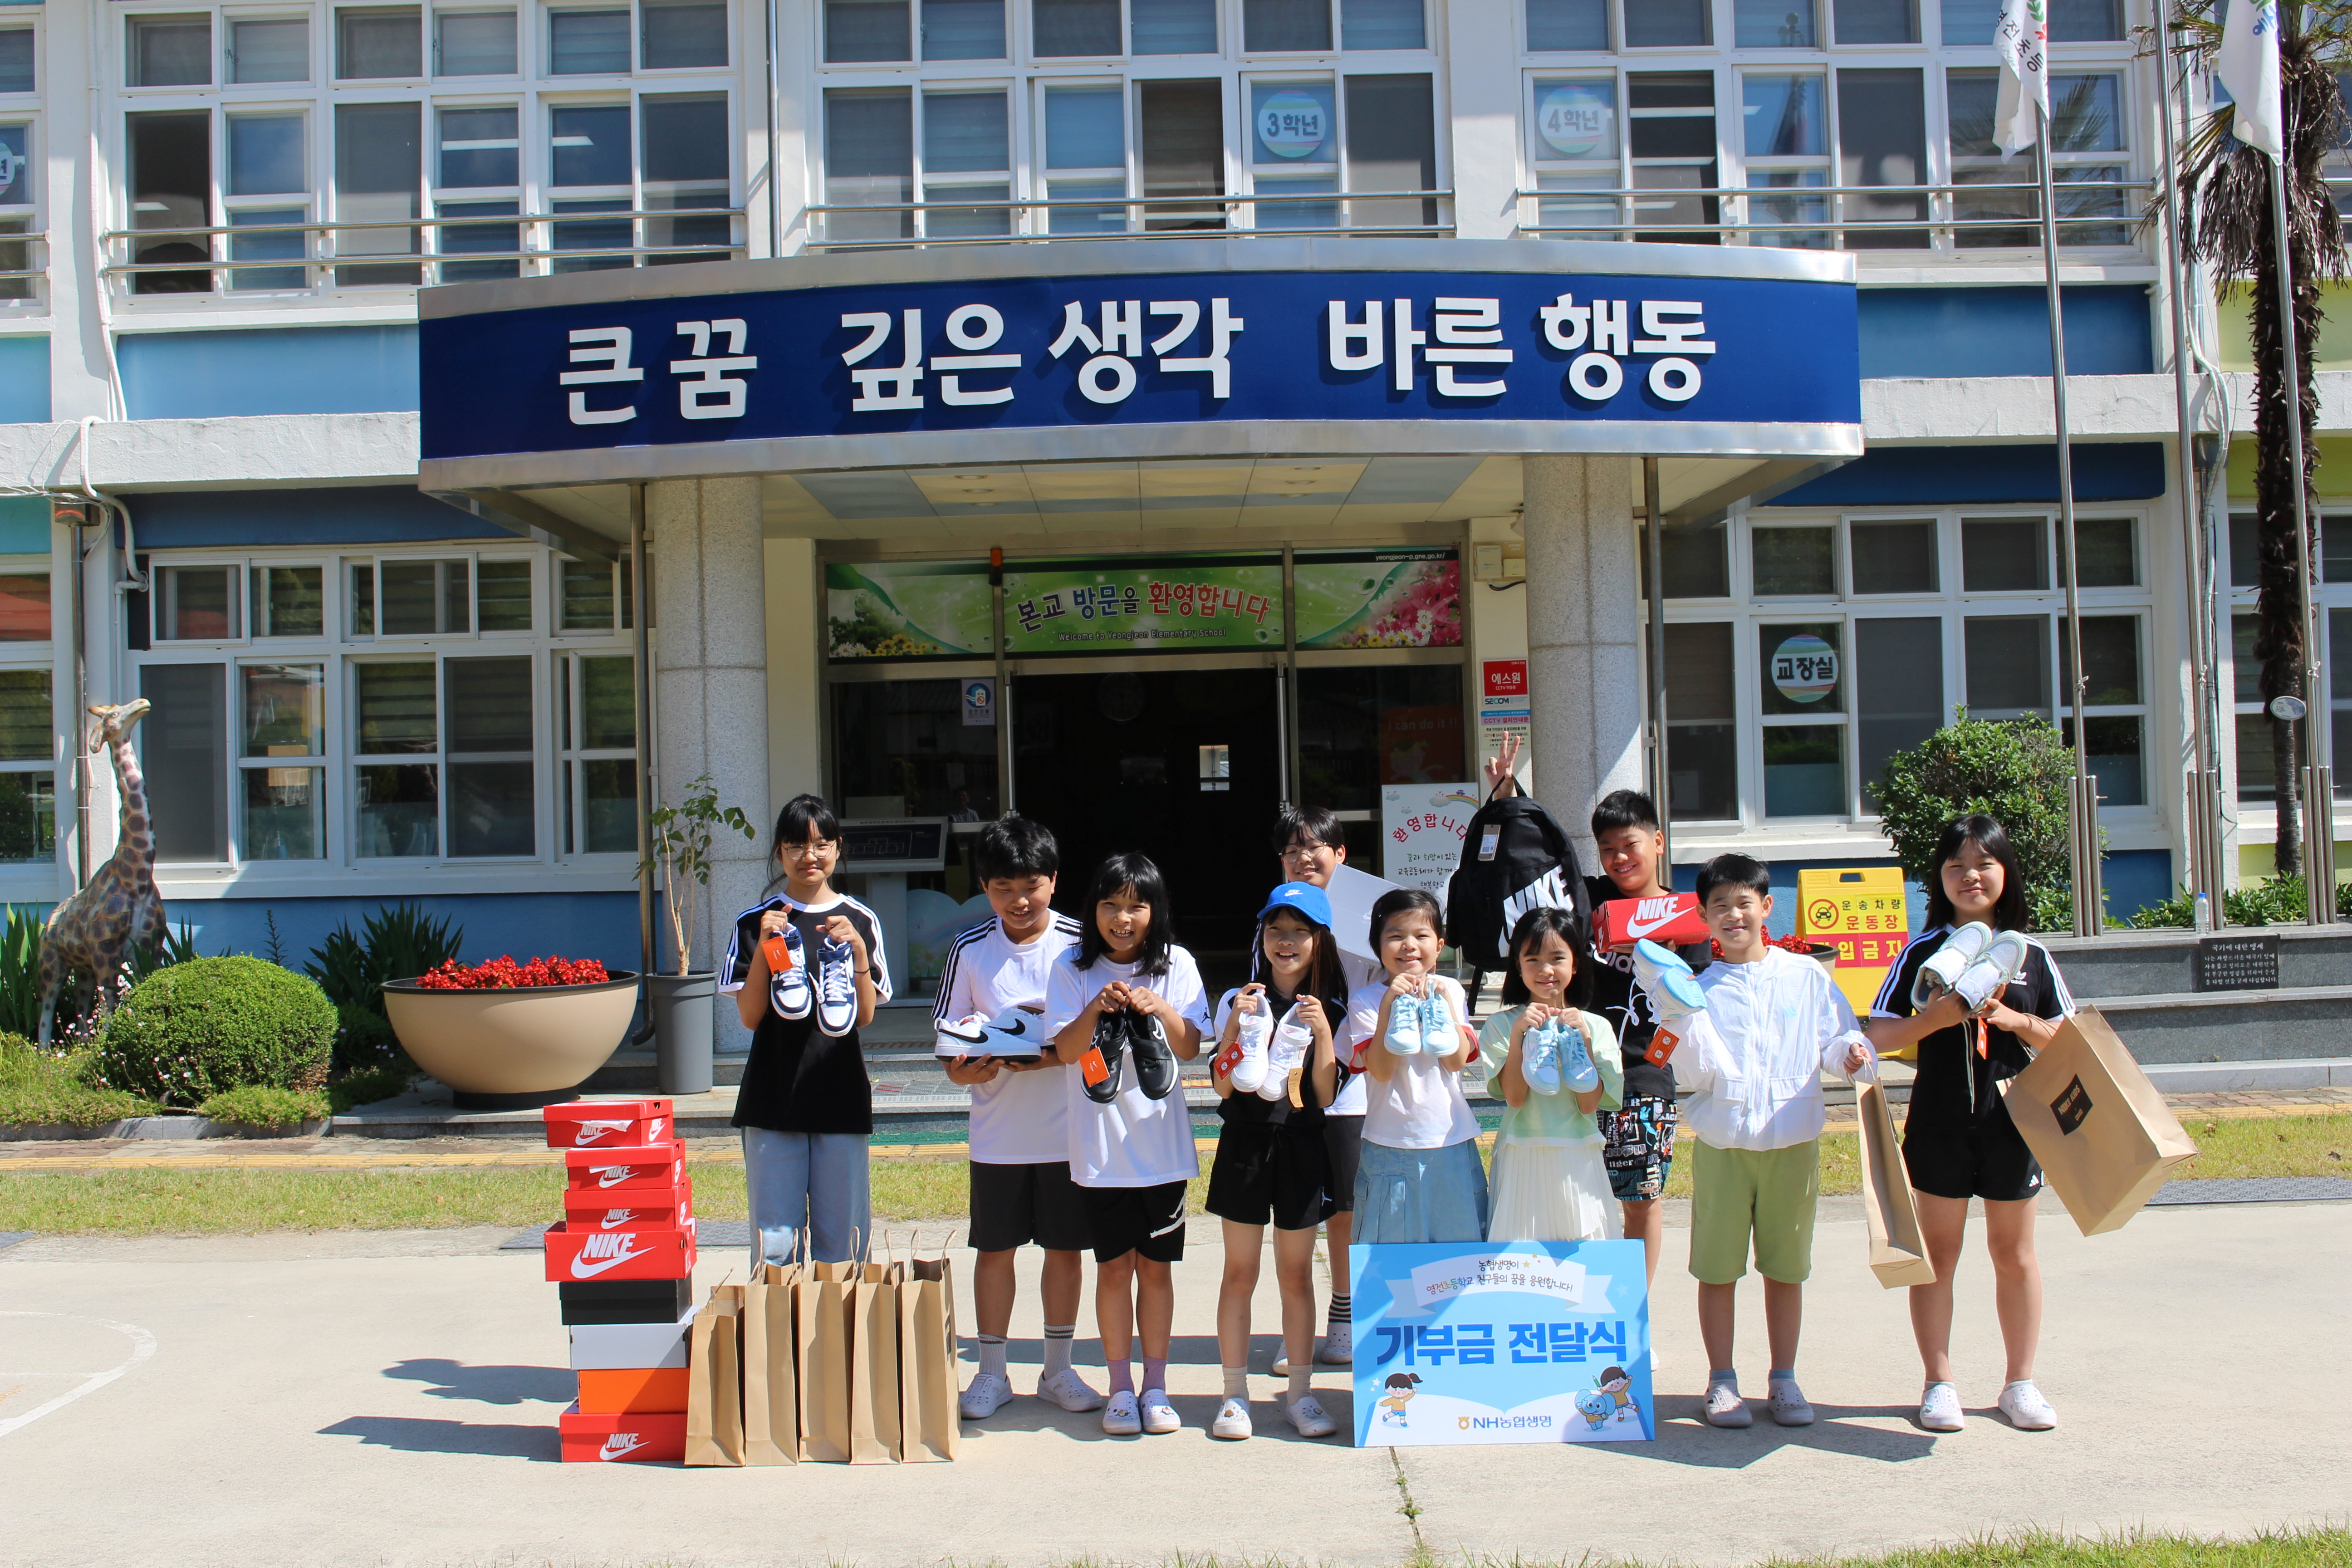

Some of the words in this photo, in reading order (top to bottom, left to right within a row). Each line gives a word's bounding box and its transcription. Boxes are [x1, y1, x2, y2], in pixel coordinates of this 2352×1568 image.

[560, 326, 644, 425] 큰
[670, 318, 757, 420] 꿈
[841, 304, 1022, 412] 깊은
[1049, 297, 1244, 404] 생각
[1329, 297, 1513, 397] 바른
[1540, 293, 1716, 402] 행동
[1017, 593, 1067, 633] 본교
[1073, 584, 1141, 620] 방문을
[1147, 581, 1270, 624] 환영합니다
[1058, 632, 1093, 641] Welcome
[1096, 632, 1105, 640] to
[1108, 631, 1149, 641] Yeongjeon
[1152, 629, 1196, 638] Elementary
[1200, 628, 1226, 637] School
[1777, 657, 1833, 681] 교장실
[1491, 672, 1520, 685] 에스원
[1396, 721, 1416, 730] can
[1420, 719, 1435, 730] do
[1438, 718, 1446, 729] it
[1392, 813, 1468, 843] 환영합니다
[1423, 853, 1443, 861] 희망이
[1445, 853, 1457, 861] 있는
[1398, 867, 1434, 876] 교육공동체가
[1420, 880, 1445, 889] 행복학교
[1503, 864, 1574, 940] NIKE
[1635, 896, 1679, 921] NIKE
[2250, 942, 2264, 951] 맹세
[2058, 1097, 2072, 1115] NIKE
[2070, 1085, 2080, 1102] KIDS
[604, 1165, 631, 1178] NIKE
[607, 1209, 631, 1220] NIKE
[582, 1233, 637, 1259] NIKE
[1479, 1259, 1519, 1272] 농협생명이
[1426, 1276, 1475, 1295] 영전초등학교
[1477, 1273, 1508, 1285] 친구들의
[1511, 1273, 1526, 1285] 꿈을
[1529, 1275, 1573, 1293] 응원합니다!
[1376, 1323, 1495, 1366] 기부금
[1508, 1321, 1627, 1363] 전달식
[1473, 1415, 1552, 1429] NH농협생명
[606, 1433, 639, 1448] NIKE
